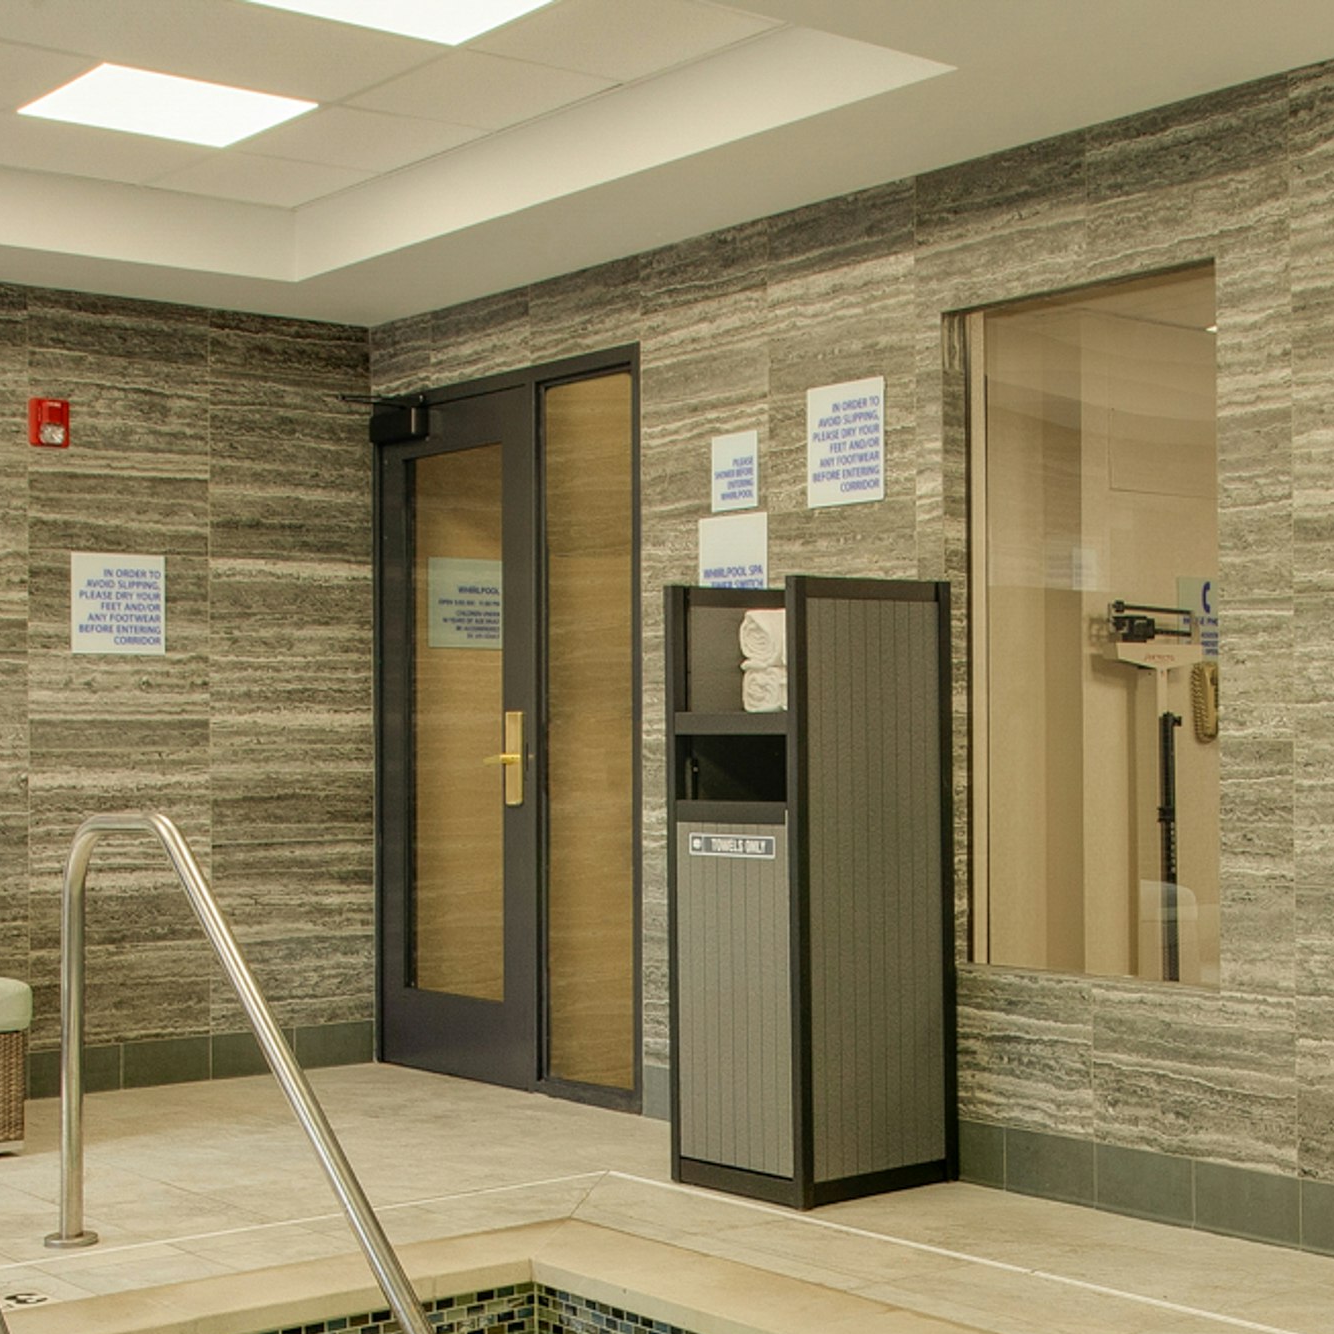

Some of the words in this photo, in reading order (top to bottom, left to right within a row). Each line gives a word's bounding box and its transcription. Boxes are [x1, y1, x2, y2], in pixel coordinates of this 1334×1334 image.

[832, 402, 841, 413] IN
[842, 398, 870, 412] ORDER
[871, 396, 880, 407] TO
[818, 414, 841, 428] AVOID
[813, 429, 839, 442] PLEASE
[841, 427, 856, 439] DRY
[858, 424, 880, 437] YOUR
[830, 441, 848, 454] FEET
[836, 452, 880, 466] FOOTWEAR
[813, 469, 840, 483] BEFORE
[842, 465, 880, 480] ENTERING
[840, 479, 880, 492] CORRIDOR
[103, 569, 114, 578] IN
[115, 569, 147, 579] ORDER
[149, 570, 161, 580] TO
[704, 566, 747, 579] WHIRLPOOL
[748, 564, 763, 575] SPA
[86, 579, 115, 589] AVOID
[78, 590, 113, 600] PLEASE
[115, 591, 134, 601] DRY
[136, 592, 161, 602] YOUR
[100, 601, 122, 611] FEET
[87, 613, 108, 622] ANY
[109, 613, 161, 623] FOOTWEAR
[78, 624, 114, 633] BEFORE
[116, 624, 161, 635] ENTERING
[114, 635, 161, 645] CORRIDOR
